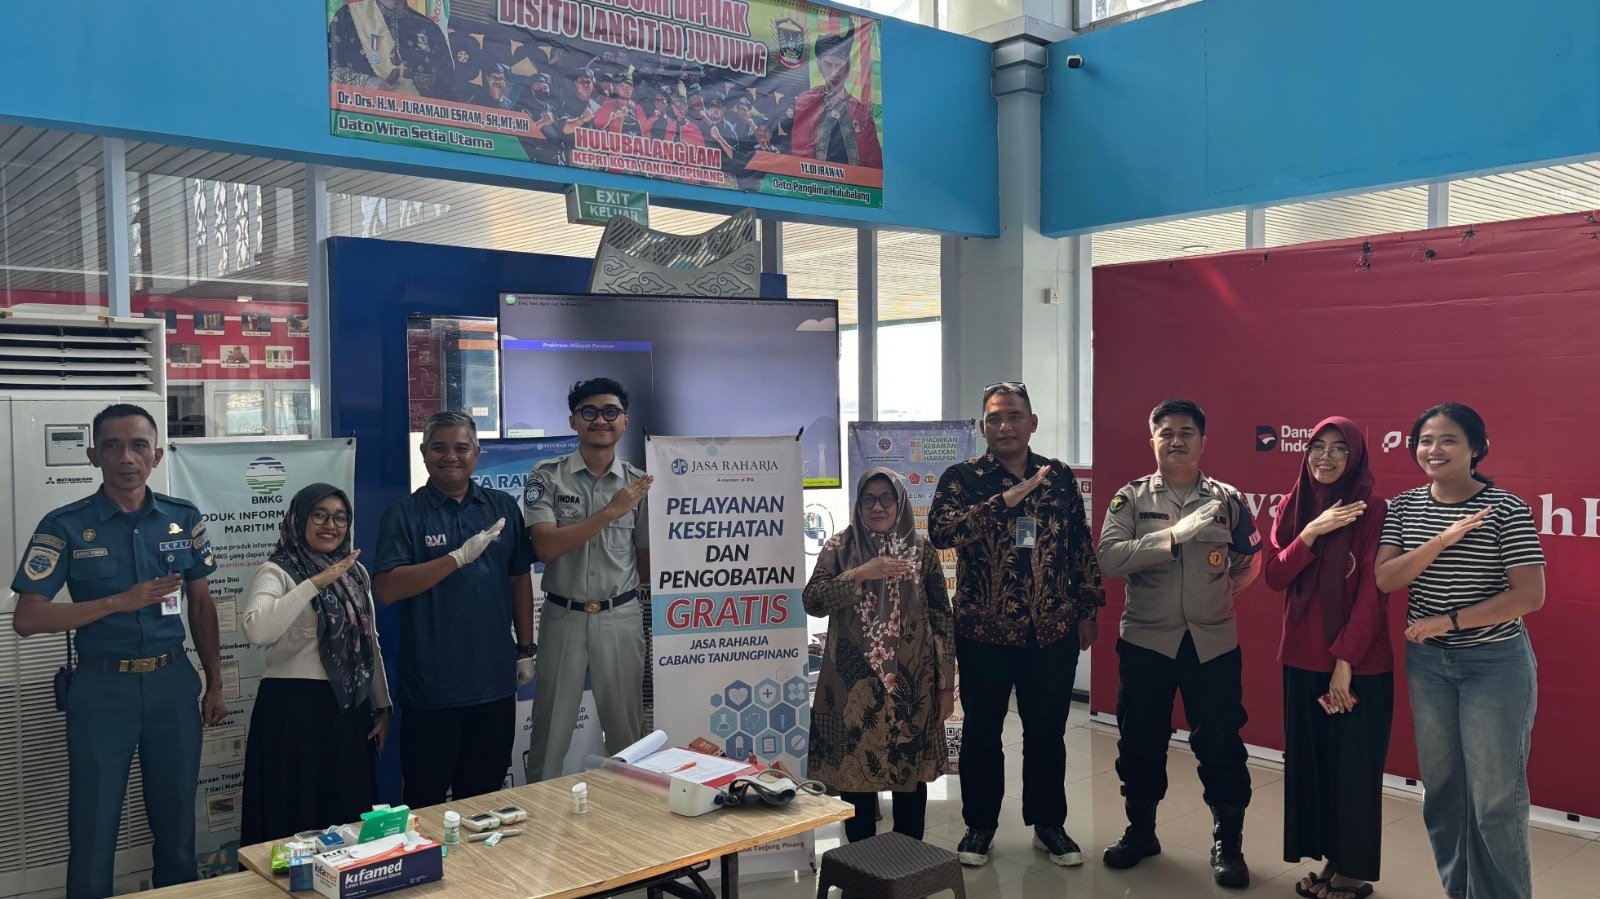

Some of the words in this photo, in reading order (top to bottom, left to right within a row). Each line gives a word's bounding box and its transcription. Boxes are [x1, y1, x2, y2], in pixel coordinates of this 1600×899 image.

[674, 0, 748, 34] DIPIJAK
[500, 0, 578, 36] DISITU
[582, 8, 657, 51] LANGIT
[660, 21, 684, 57] DI
[686, 27, 767, 76] JUNJUNG
[337, 91, 353, 105] Dr.
[355, 93, 375, 107] Drs.
[377, 96, 399, 112] H.M.
[400, 99, 449, 120] JURAMADI
[451, 108, 485, 127] ESRAM,
[338, 116, 373, 133] Dato
[376, 122, 408, 139] Wira
[411, 127, 446, 144] Setia
[449, 132, 494, 149] Utama
[574, 127, 687, 165] HULUBALANG
[687, 145, 722, 169] LAM
[572, 151, 608, 167] KEPRI
[609, 155, 639, 172] KOTA
[639, 159, 725, 183] TANJUNGPINANG
[596, 190, 630, 204] EXIT
[773, 179, 792, 192] Dato
[793, 181, 828, 196] Panglima
[829, 186, 870, 204] Hulubalang
[692, 461, 718, 472] JASA
[722, 460, 778, 471] RAHARJA
[252, 495, 283, 504] BMKG
[557, 494, 580, 504] INDRA
[666, 496, 784, 515] PELAYANAN
[201, 512, 236, 522] ODUK
[240, 510, 285, 520] INFORM
[224, 523, 275, 533] MARITIM
[668, 519, 784, 539] KESEHATAN
[705, 544, 749, 563] DAN
[659, 566, 795, 589] PENGOBATAN
[666, 593, 790, 630] GRATIS
[690, 639, 717, 650] JASA
[718, 635, 769, 648] RAHARJA
[659, 655, 706, 667] CABANG
[708, 648, 799, 664] TANJUNGPINANG
[782, 840, 805, 849] Pinang
[315, 863, 337, 882] kifamed
[345, 859, 402, 884] kifamed
